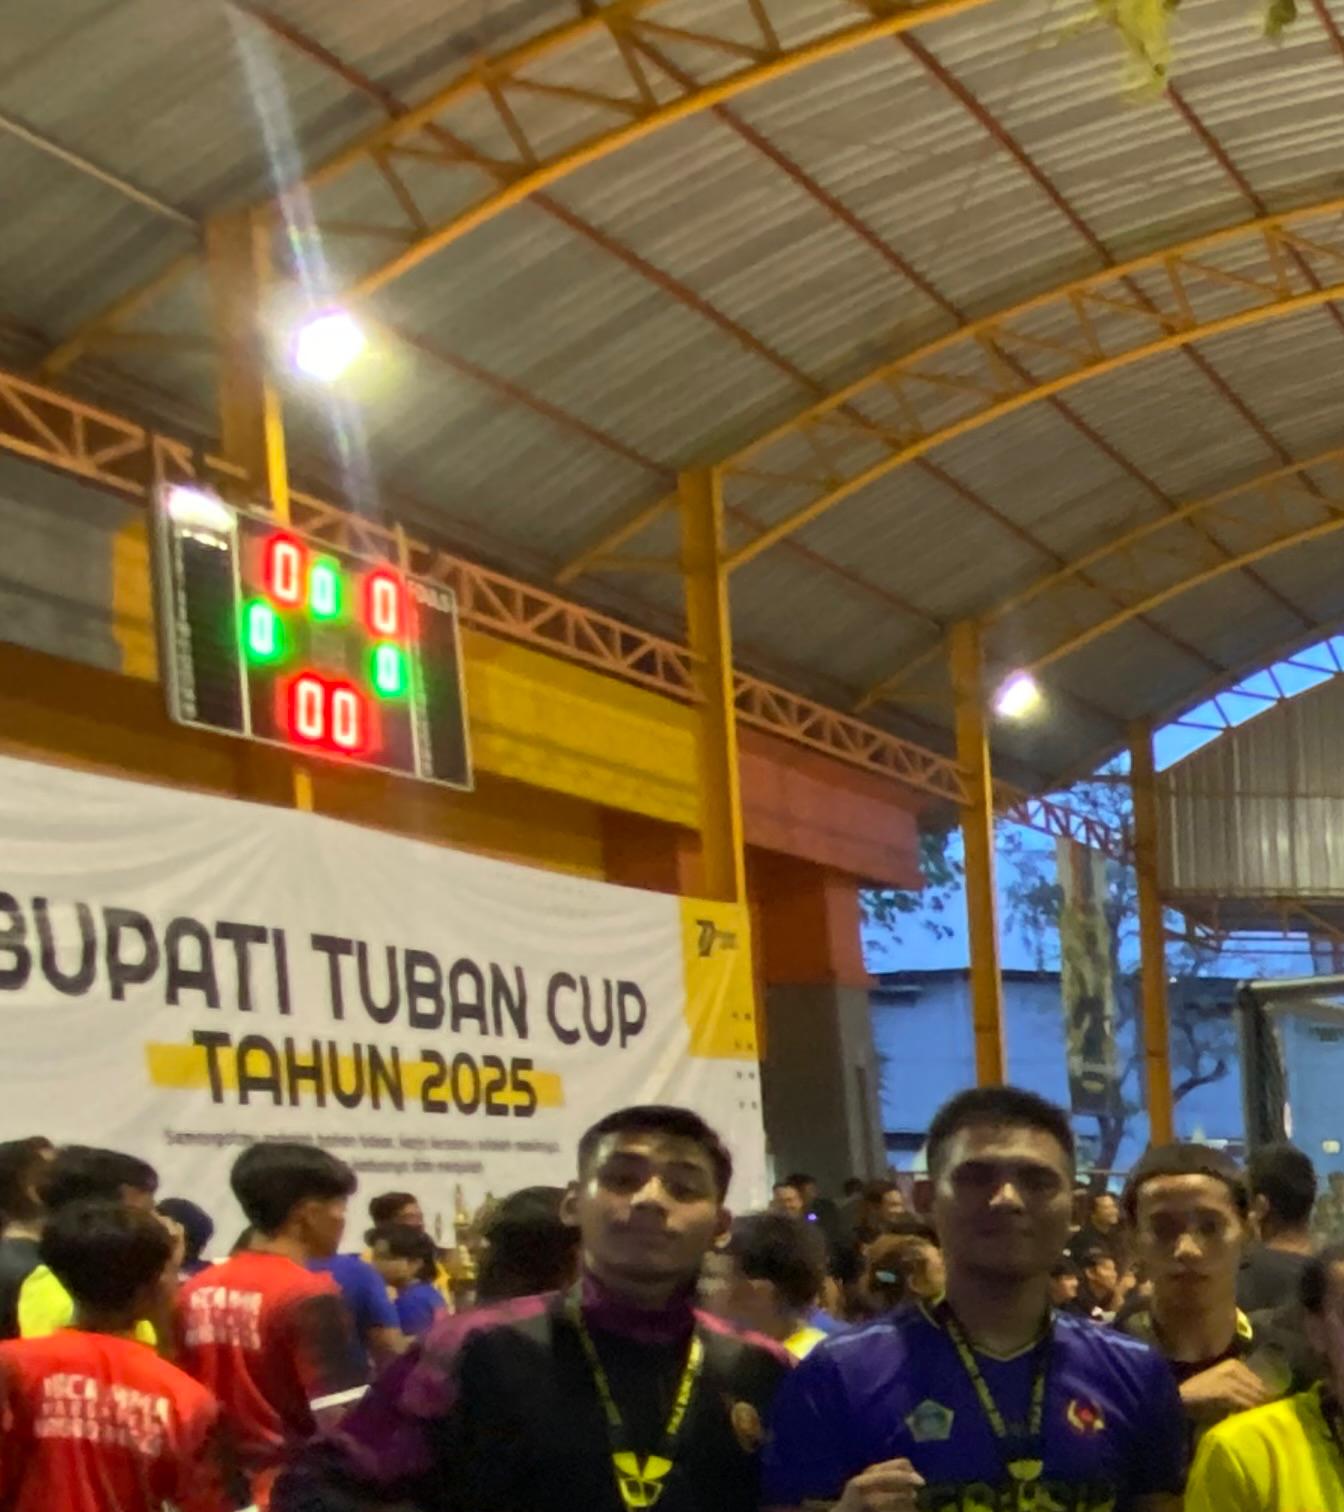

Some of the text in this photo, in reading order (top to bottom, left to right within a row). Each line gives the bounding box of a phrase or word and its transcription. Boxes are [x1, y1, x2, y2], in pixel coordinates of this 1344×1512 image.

[0, 891, 648, 1049] BUPATI TUBAN CUP
[192, 1029, 538, 1118] TAHUN 2025
